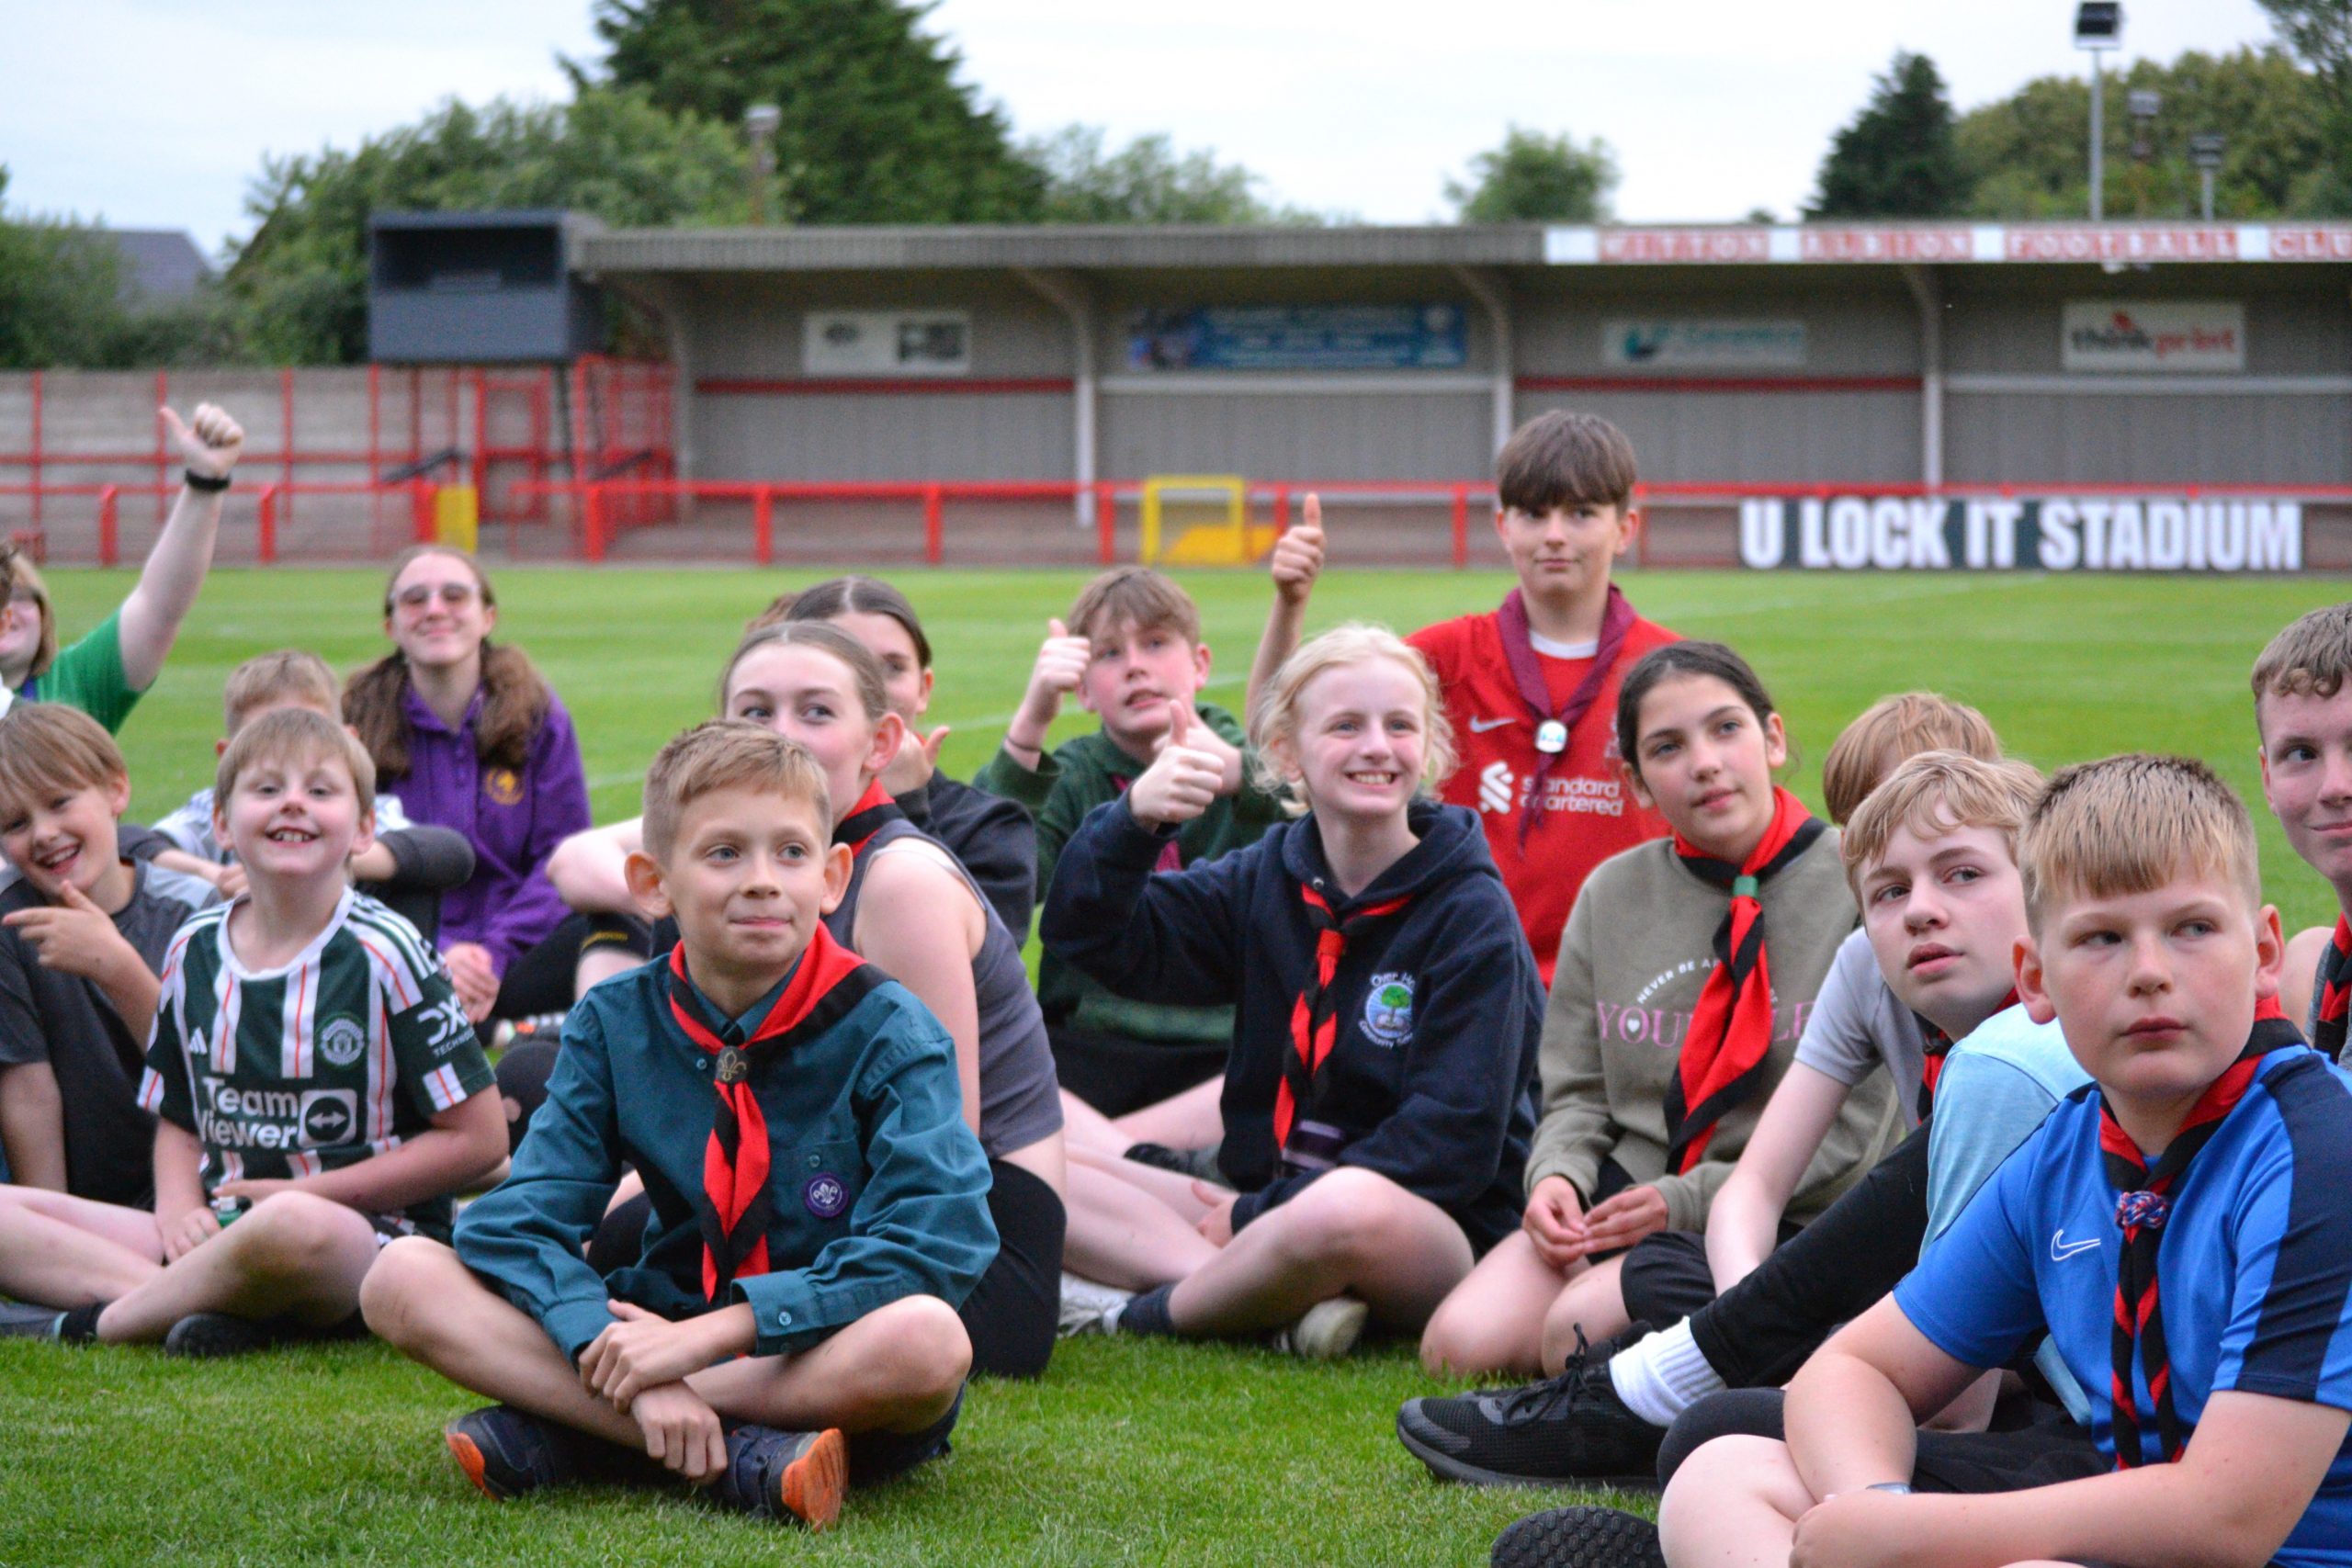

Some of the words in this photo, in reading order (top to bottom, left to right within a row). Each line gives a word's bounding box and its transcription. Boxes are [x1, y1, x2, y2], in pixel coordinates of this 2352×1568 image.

[2009, 231, 2236, 259] FOOTBALL
[2271, 230, 2352, 258] CLU
[1739, 496, 1785, 570] U
[1799, 496, 1951, 570] LOCK
[1964, 496, 2024, 570] IT
[2038, 496, 2303, 570] STADIUM
[1636, 969, 1674, 1005] NEVER
[1678, 960, 1695, 975] BE
[202, 1076, 299, 1118] Team
[198, 1109, 299, 1148] Viewer
